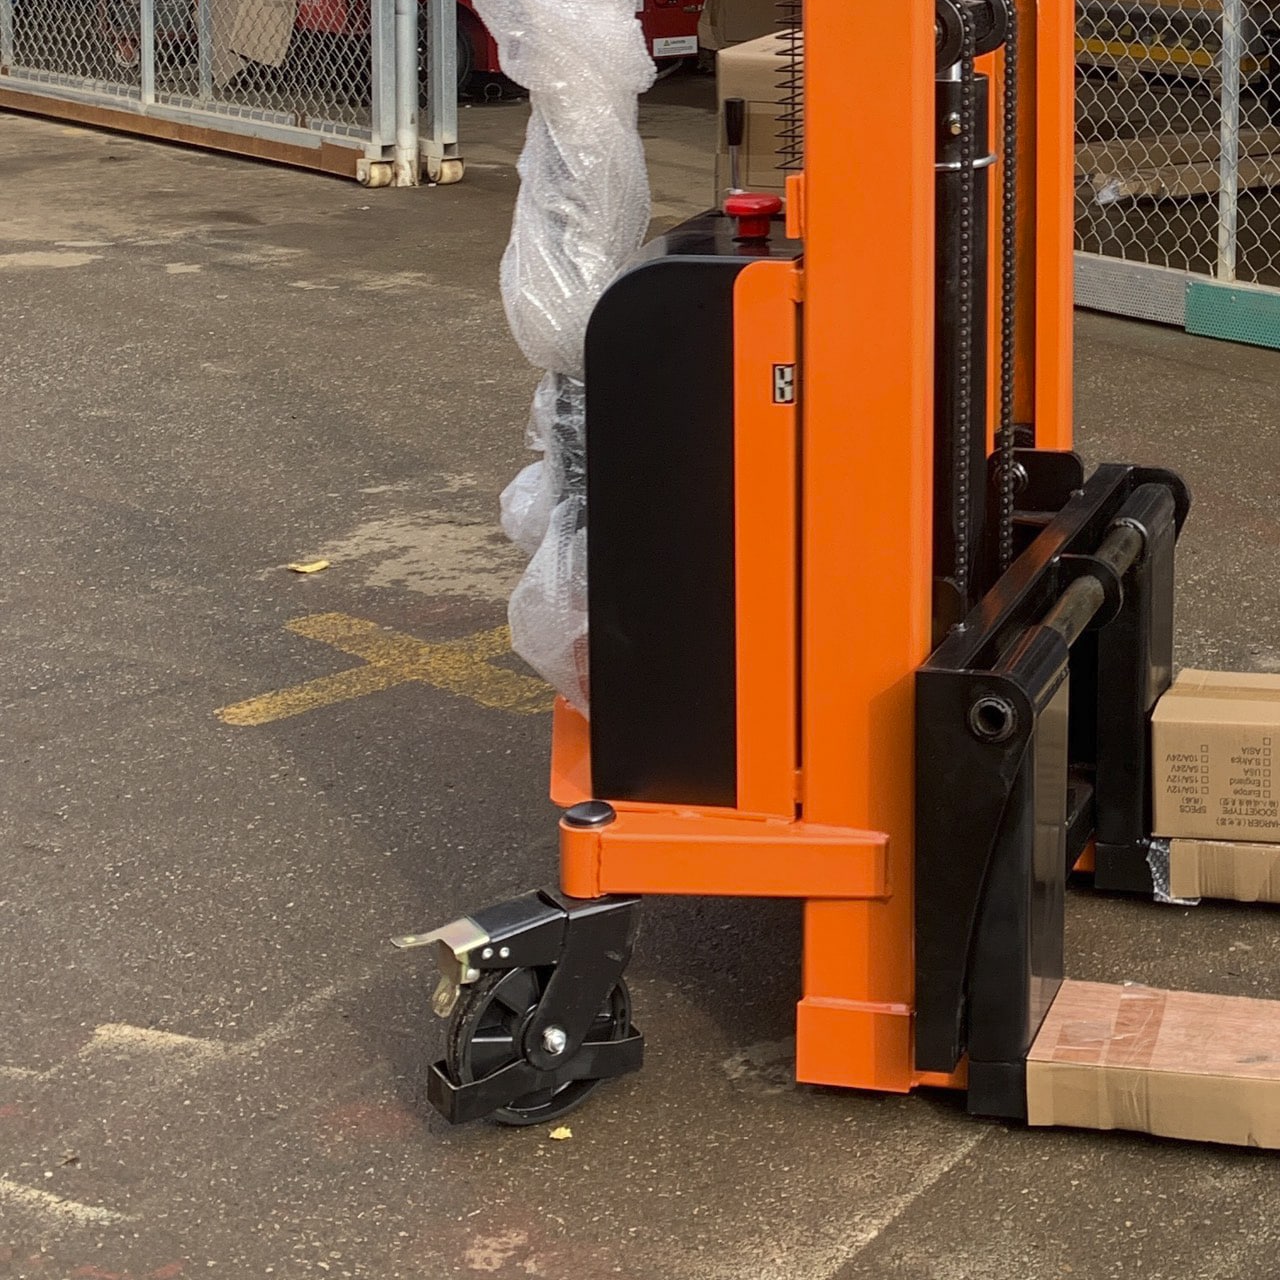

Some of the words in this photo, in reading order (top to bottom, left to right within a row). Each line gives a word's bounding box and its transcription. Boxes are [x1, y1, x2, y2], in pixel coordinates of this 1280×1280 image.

[1241, 747, 1261, 755] ASIA
[1243, 768, 1261, 776] USA
[1229, 778, 1261, 787] England
[1233, 788, 1261, 798] Europe
[1179, 805, 1207, 814] SPECS
